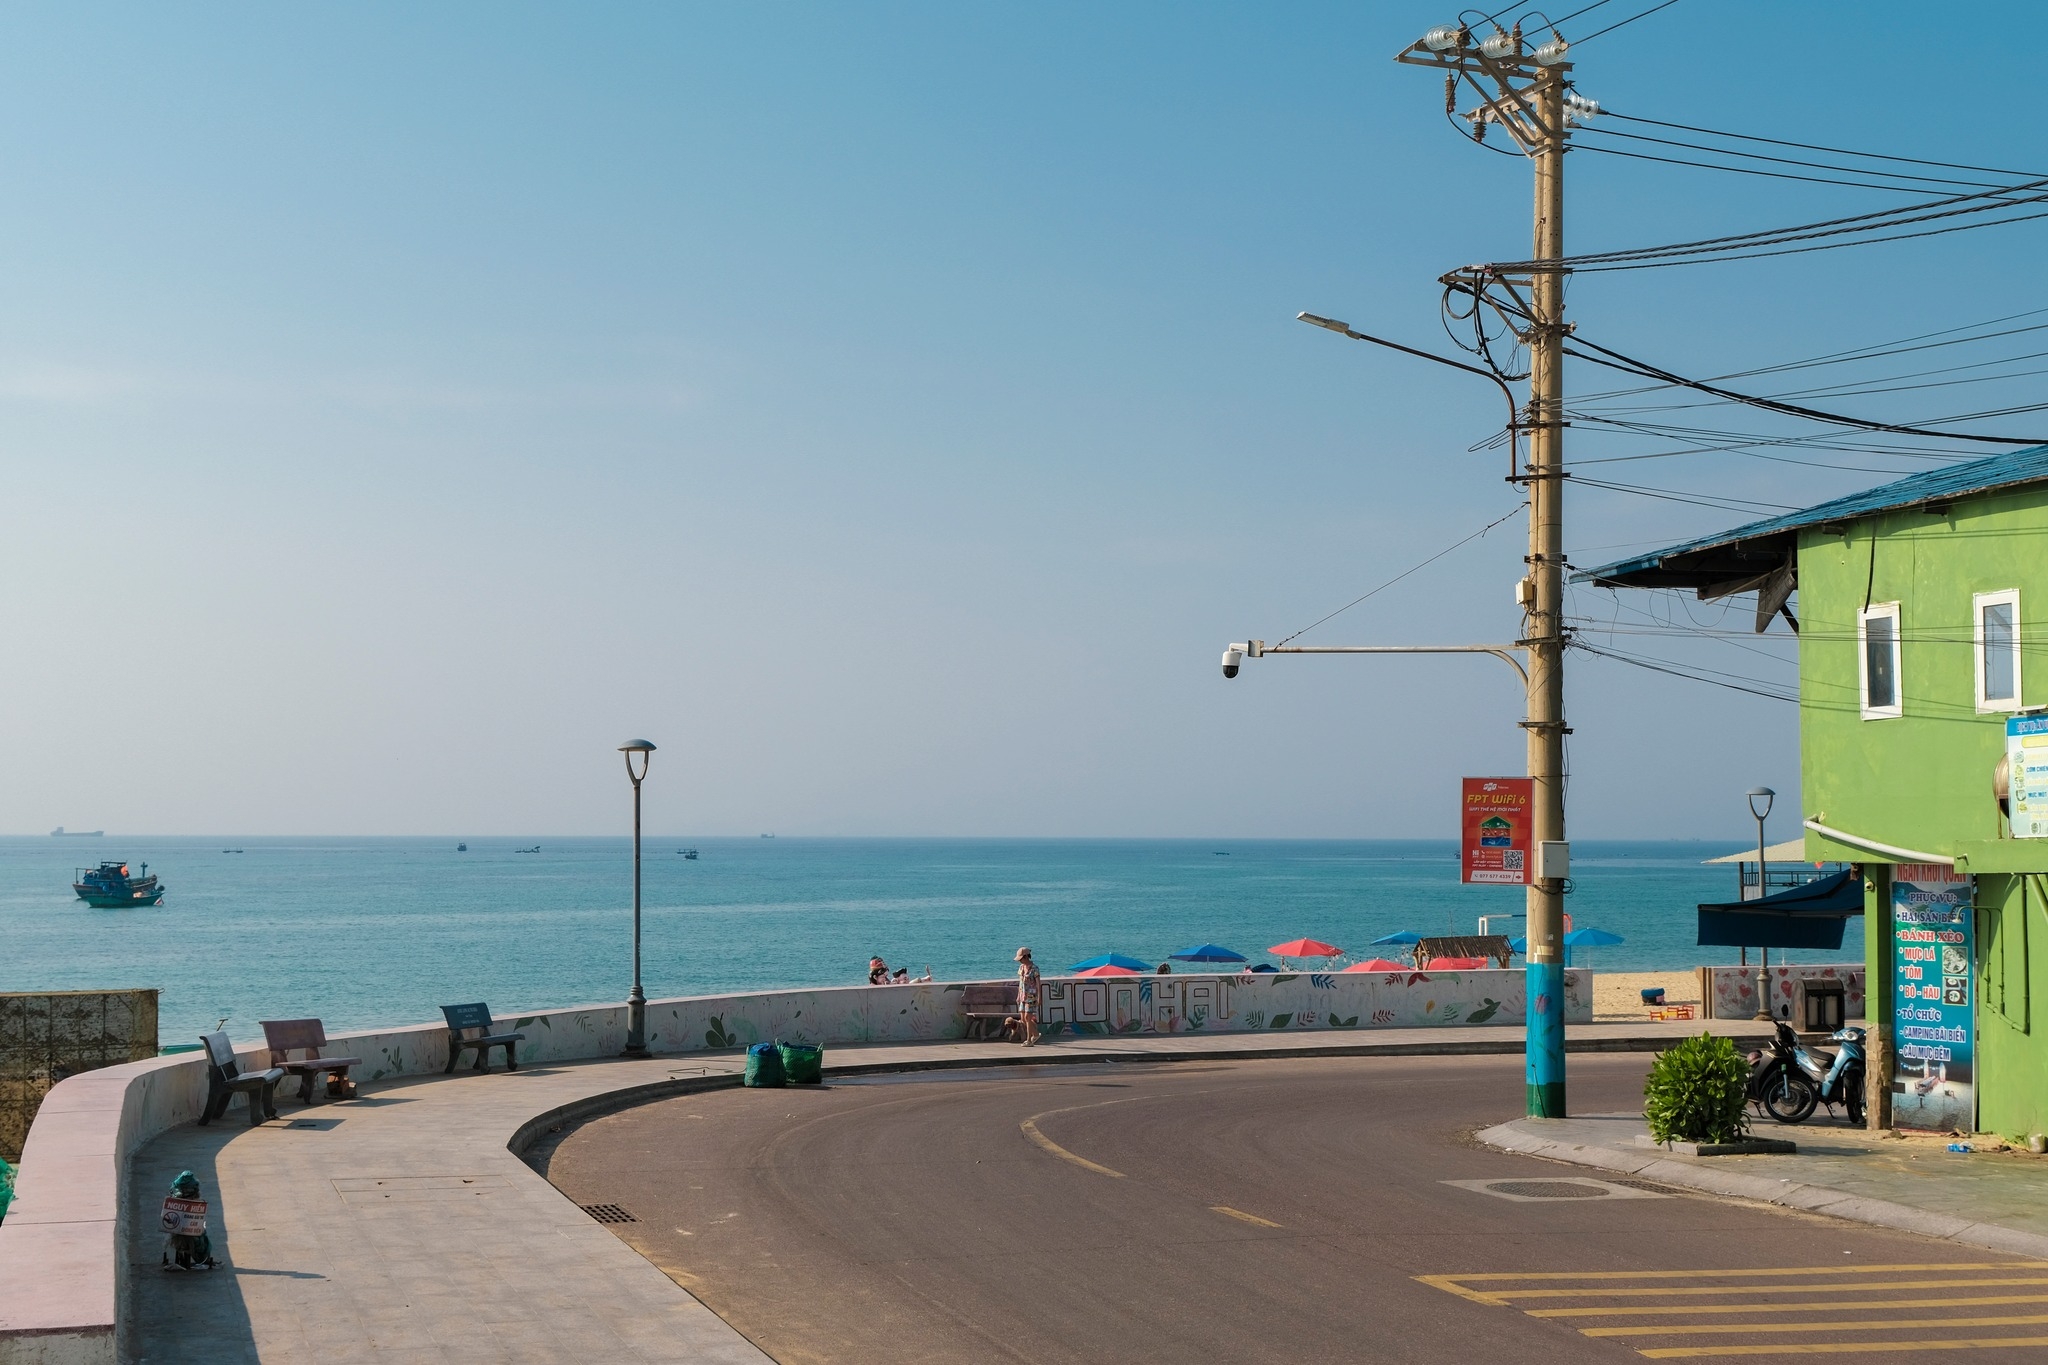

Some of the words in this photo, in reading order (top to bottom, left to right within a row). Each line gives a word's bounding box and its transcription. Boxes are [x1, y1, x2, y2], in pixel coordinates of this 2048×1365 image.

[1467, 794, 1489, 804] FPT
[1492, 794, 1516, 804] WiFi
[1519, 795, 1526, 805] 6
[1910, 893, 1936, 905] PHỤC
[1901, 928, 1935, 941] BÁNH
[1937, 930, 1964, 943] XÈO
[1904, 947, 1923, 963] MỰC
[1924, 946, 1936, 961] LÁ
[1904, 964, 1922, 979] TÔM
[1915, 1007, 1942, 1022] CHỨC
[1903, 1025, 1934, 1040] CAMPING
[167, 1201, 189, 1211] NGUY
